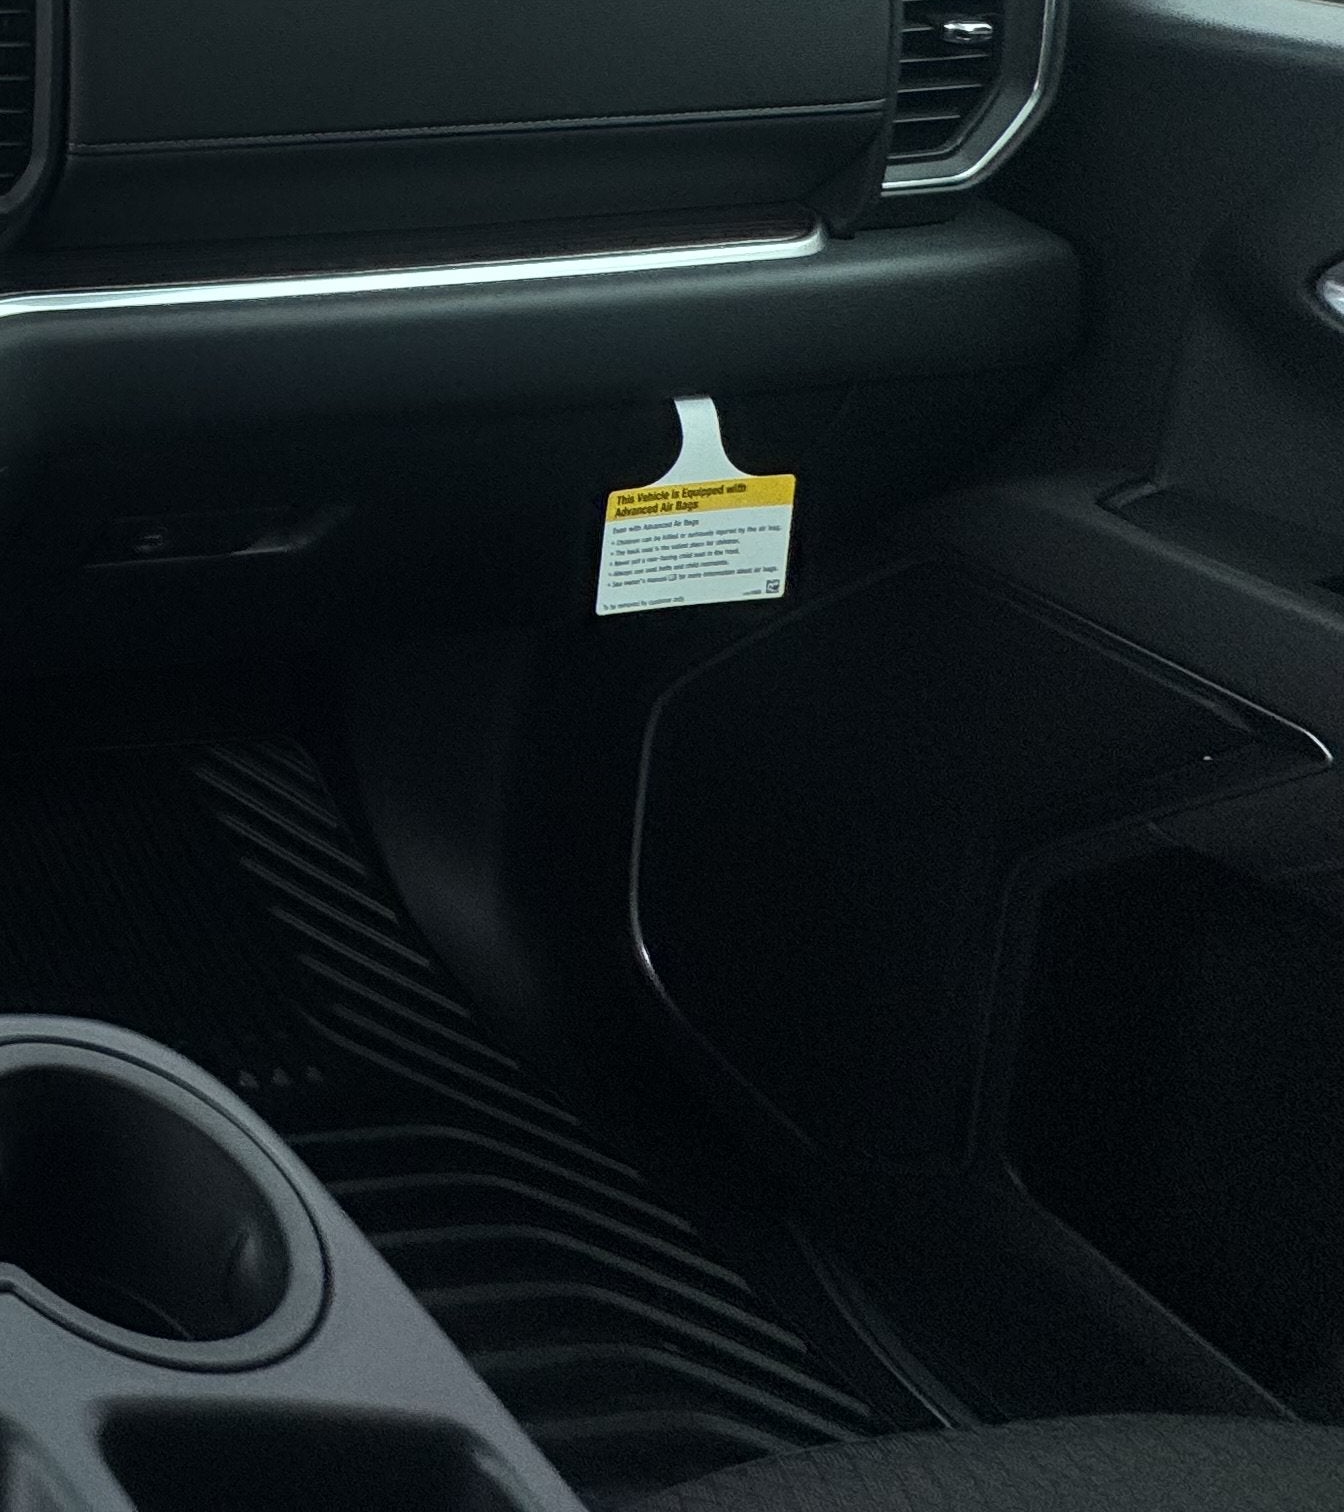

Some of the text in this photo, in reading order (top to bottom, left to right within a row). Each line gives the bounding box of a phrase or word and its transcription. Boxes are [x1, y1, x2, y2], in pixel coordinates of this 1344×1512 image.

[617, 494, 635, 506] This
[638, 491, 671, 503] Vehicle
[682, 485, 725, 499] Equipped
[726, 483, 747, 493] with
[615, 500, 699, 518] Advanced Air Bags
